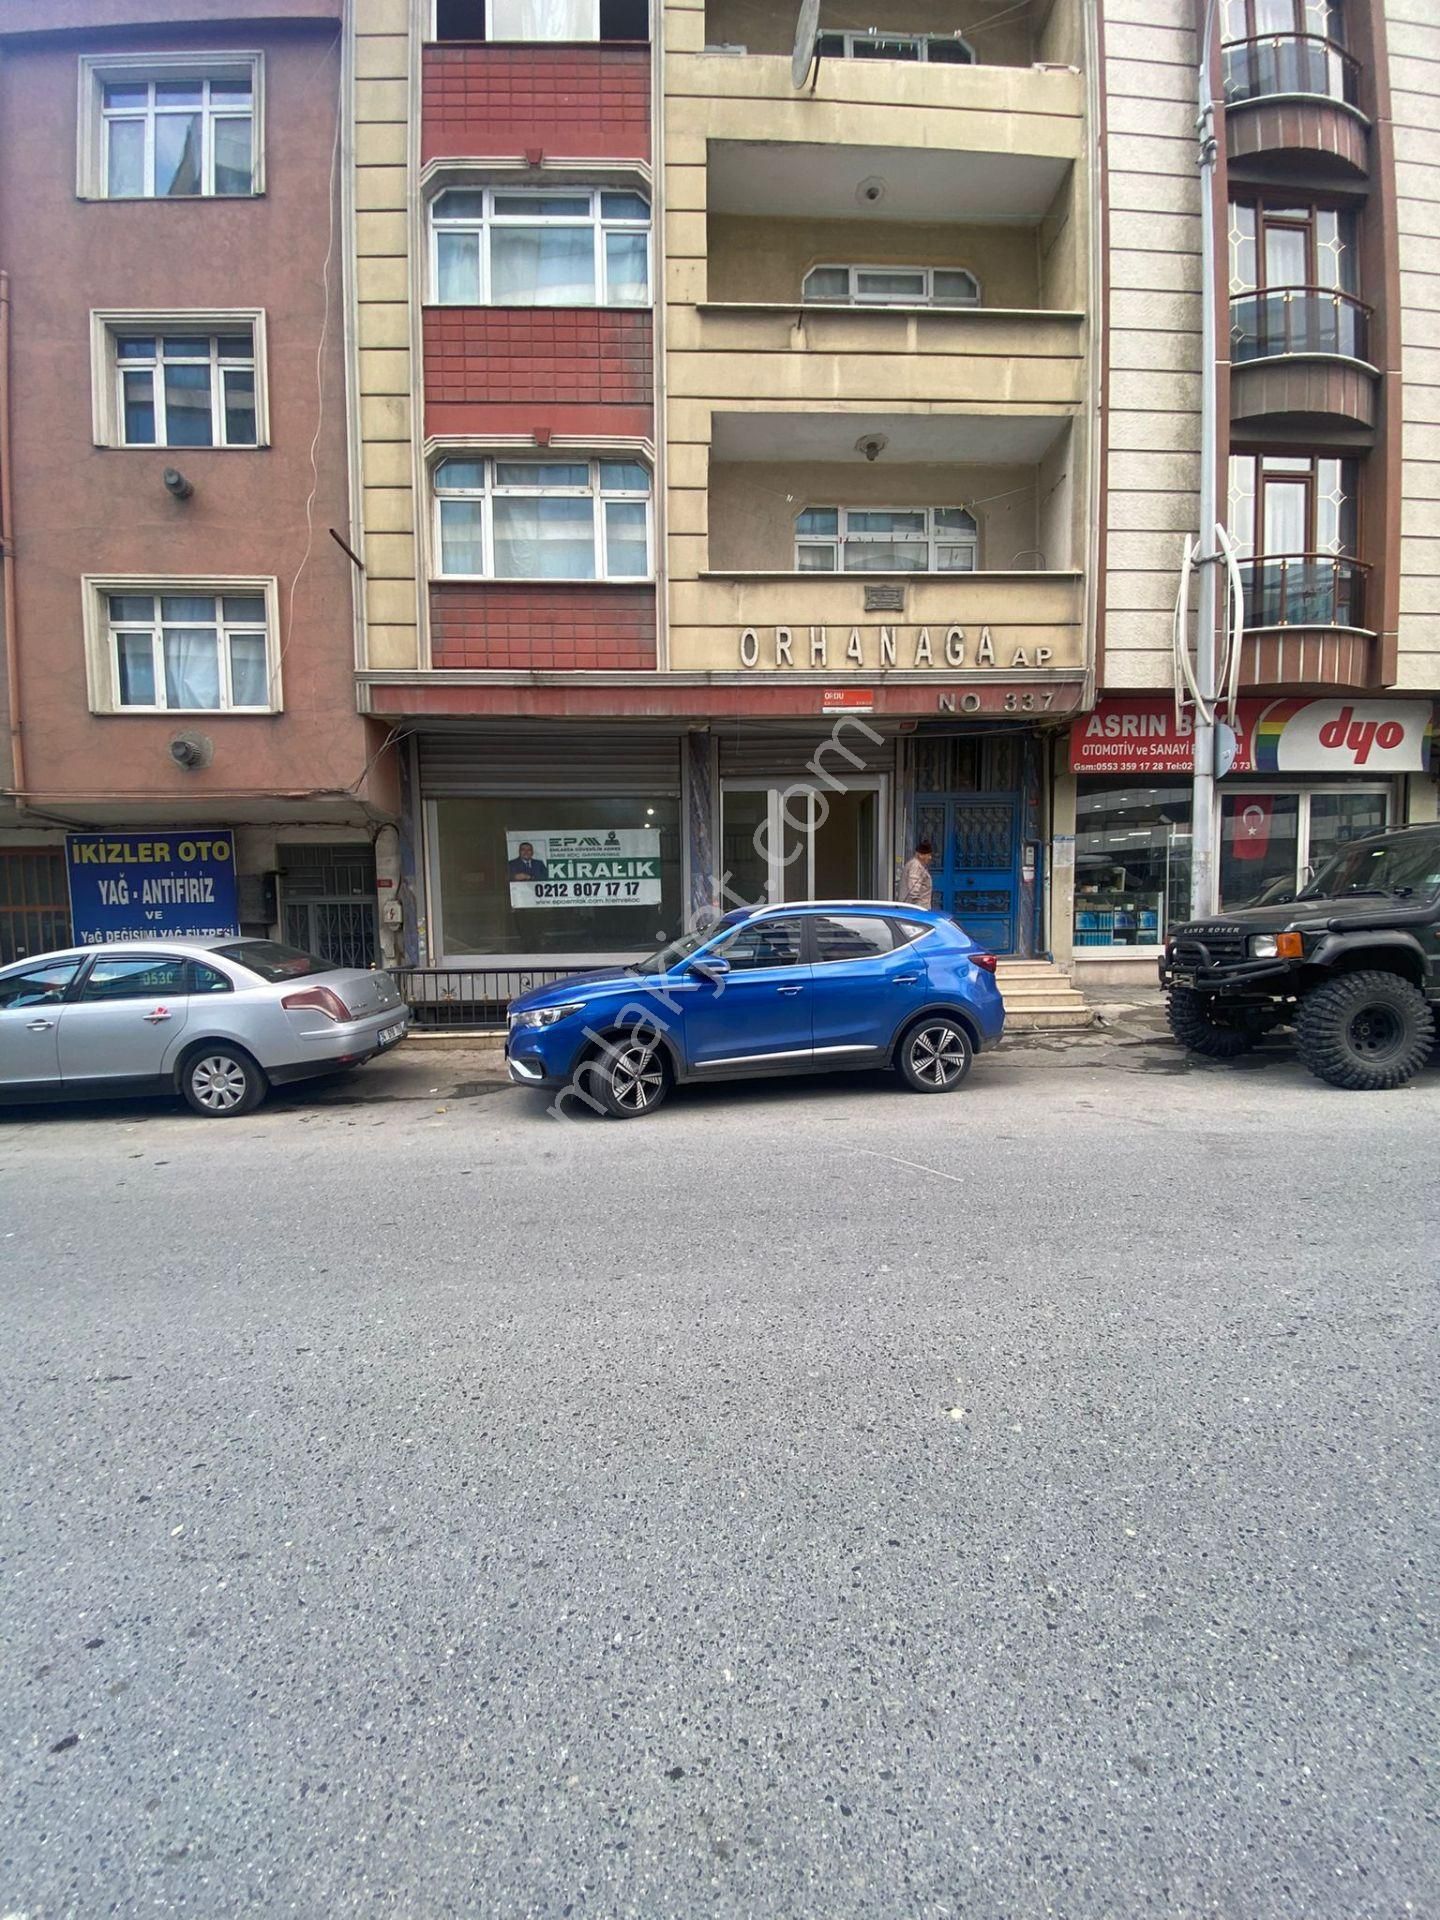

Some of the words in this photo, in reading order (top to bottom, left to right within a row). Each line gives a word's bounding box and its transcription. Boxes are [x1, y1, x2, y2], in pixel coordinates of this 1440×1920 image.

[740, 625, 997, 667] ORHANAGA
[1011, 647, 1054, 667] AP
[938, 693, 981, 713] NO
[1004, 691, 1055, 713] 337
[1085, 714, 1167, 738] ASRIN
[1319, 706, 1405, 765] dyo
[1082, 741, 1135, 756] OTOMOTİV
[1136, 746, 1148, 756] ve
[1150, 740, 1190, 756] SANAYİ
[1073, 762, 1119, 771] Gsm:0553
[1120, 762, 1137, 770] 359
[1140, 762, 1150, 770] 17
[1152, 762, 1164, 770] 28
[1240, 762, 1251, 770] 73
[72, 838, 171, 864] İKİZLER
[178, 841, 230, 862] OTO
[548, 860, 656, 879] KİRALIK
[98, 872, 130, 906] YAĞ
[143, 871, 216, 904] ANTİFİRİZ
[535, 883, 568, 898] 0212
[573, 882, 602, 897] 807
[605, 882, 621, 896] 17
[625, 882, 640, 896] 17
[145, 911, 163, 920] VE
